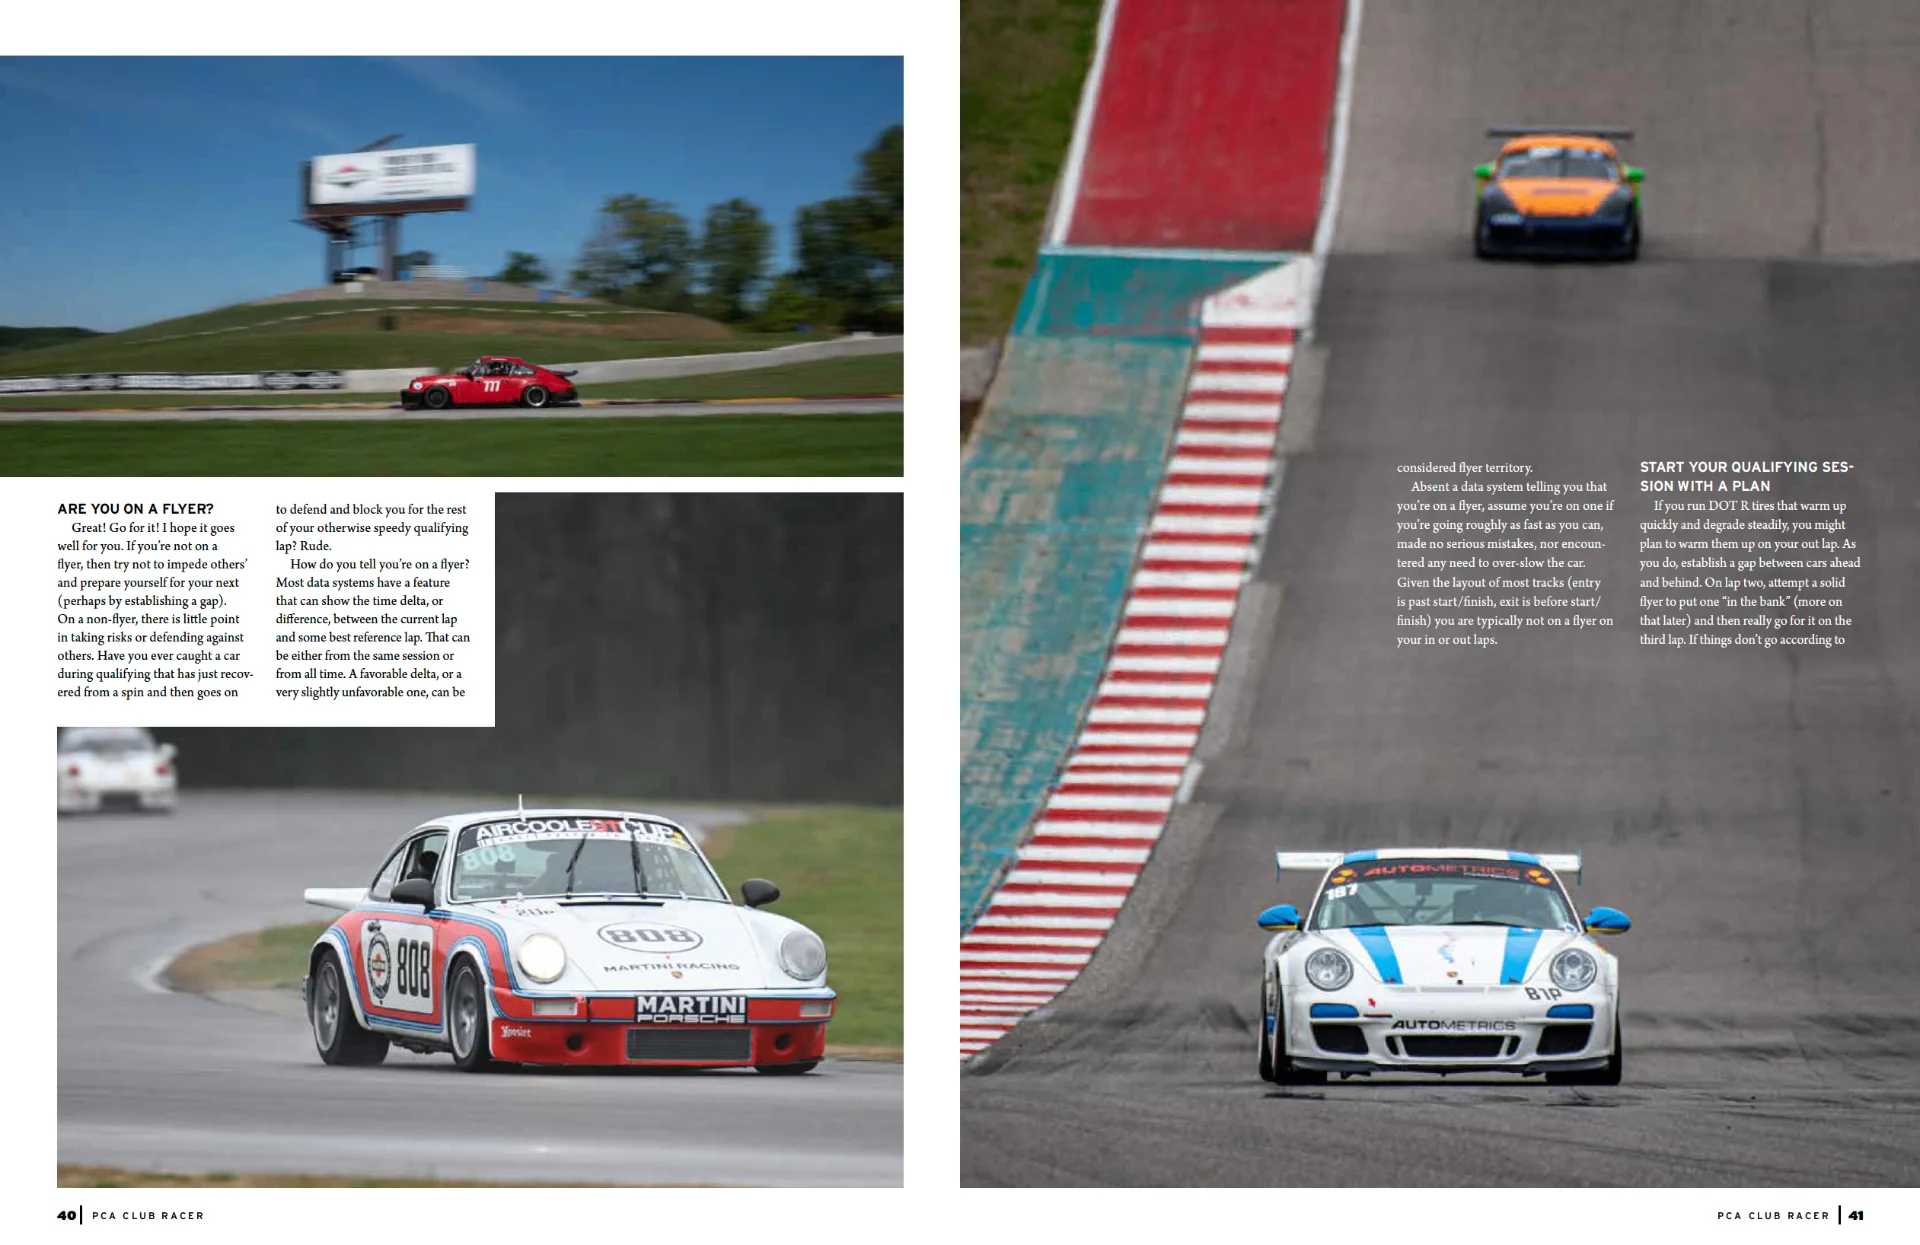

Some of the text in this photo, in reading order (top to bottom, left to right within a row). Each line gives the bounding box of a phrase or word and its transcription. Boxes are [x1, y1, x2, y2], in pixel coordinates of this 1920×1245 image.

[1396, 461, 1533, 477] considered flyer territory.
[1640, 460, 1855, 474] START YOUR QUALIFYING SES-
[1410, 480, 1608, 496] Absent a data system telling you that
[1640, 479, 1771, 492] SION WITH A PLAN
[57, 503, 214, 515] ARE YOU ON A FLYER?
[276, 503, 467, 518] to defend and block you for the rest
[1396, 499, 1616, 515] you’re on a flyer, assume you’re on one if
[1653, 499, 1847, 515] If you run DOT R tires that warm up
[71, 521, 235, 537] Great! Go for it! I hope it goes
[275, 521, 469, 537] of your otherwise speedy qualifying
[1396, 518, 1604, 534] you’re going roughly as fast as you can,
[1639, 518, 1846, 534] quickly and degrade steadily, you might
[57, 539, 218, 555] well for you. If you’re not on a
[1396, 537, 1606, 551] made no serious mistakes, nor encoun-
[1639, 537, 1857, 553] plan to warm them up on your out lap. As
[57, 558, 248, 573] flyer, then try not to impede others’
[290, 558, 470, 573] How do you tell you’re on a flyer?
[57, 576, 239, 592] and prepare yourself for your next
[275, 576, 451, 591] Most data systems have a feature
[621, 820, 674, 840] CUP
[462, 846, 516, 871] 808
[1363, 864, 1520, 878] AUTOMETRICS
[605, 928, 695, 943] 808
[397, 937, 431, 998] 808
[603, 962, 741, 972] MARTINI RACING
[637, 996, 746, 1013] MARTINI
[637, 1014, 745, 1023] PORSCHE
[1391, 1019, 1517, 1031] AUTOMETRICS
[56, 1210, 204, 1221] 40 PCA CLUB RACER
[1717, 1210, 1864, 1221] PCA CLUB RACER 41
